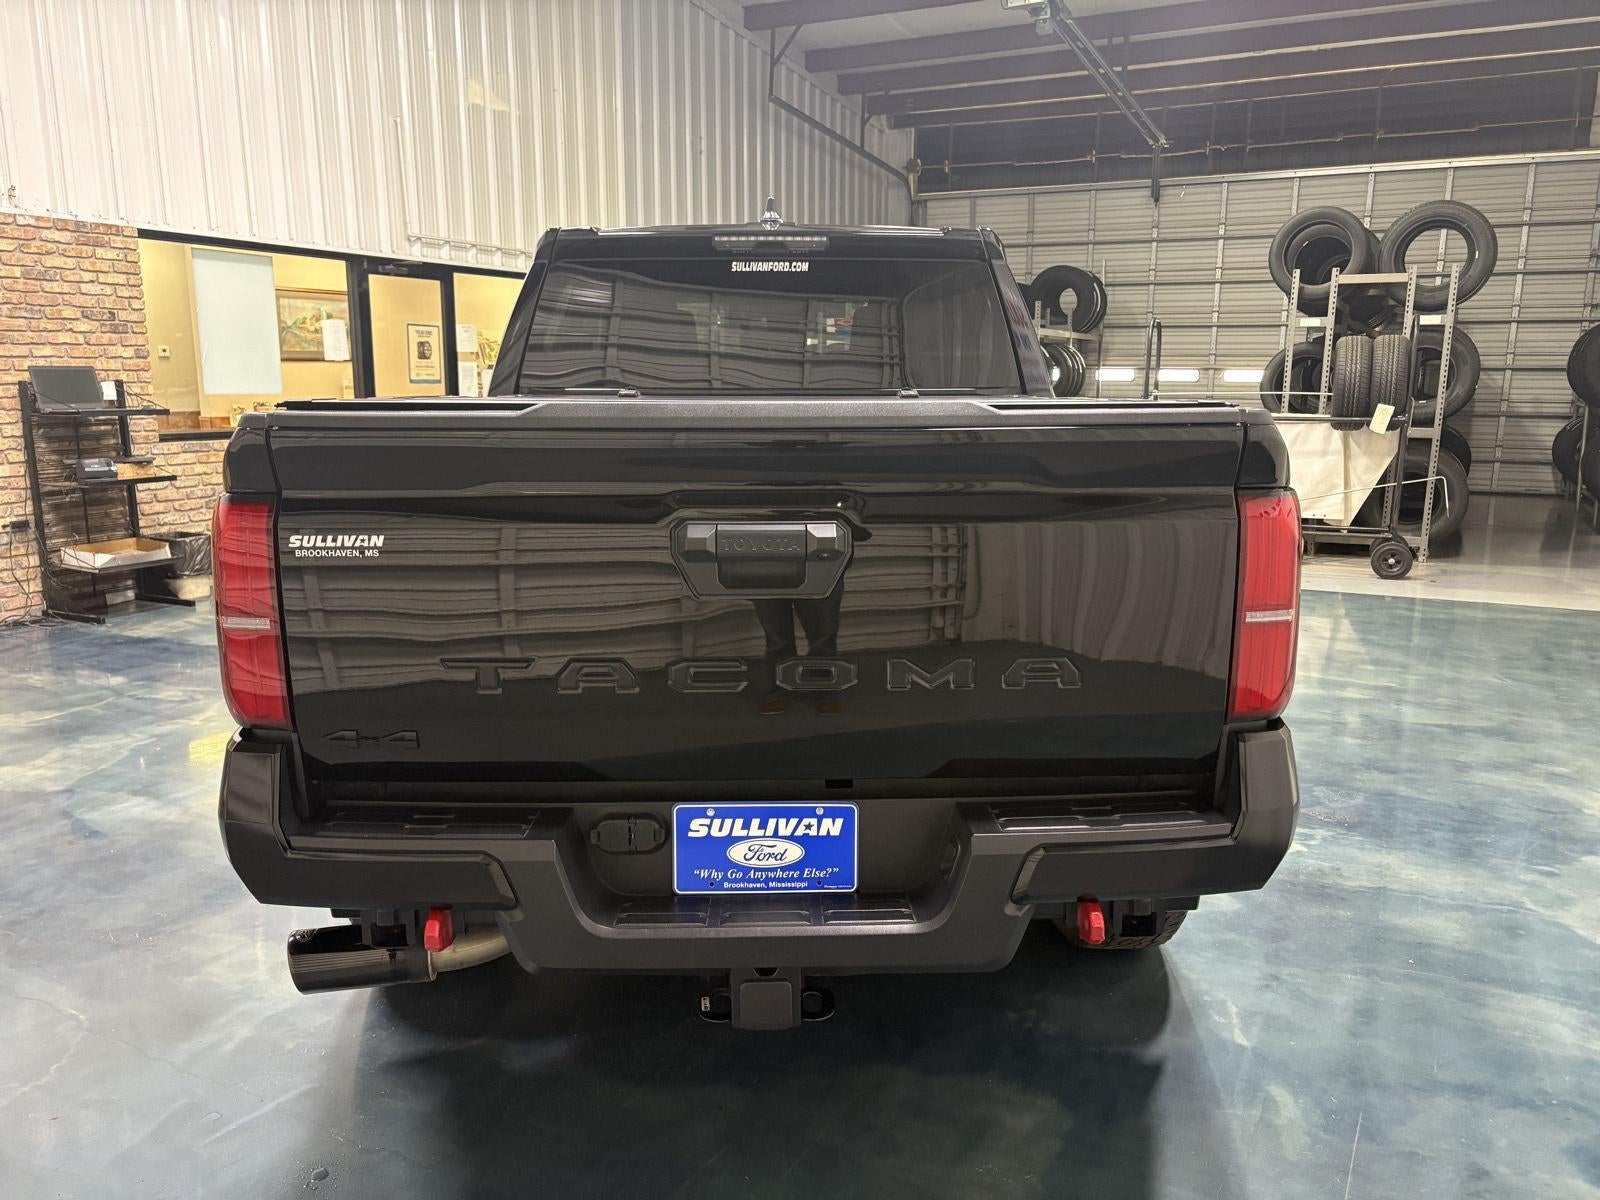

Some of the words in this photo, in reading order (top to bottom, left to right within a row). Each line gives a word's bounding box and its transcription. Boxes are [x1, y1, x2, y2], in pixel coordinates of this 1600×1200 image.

[731, 261, 810, 272] SULLIVANFORD.COM
[288, 534, 385, 548] SULLIVAN
[295, 549, 363, 558] BROOKHAVEN,
[364, 549, 380, 557] MS
[440, 656, 1084, 694] TACOMA
[688, 818, 844, 838] SULLIVAN
[743, 843, 788, 862] Ford
[727, 868, 743, 879] Go
[746, 867, 800, 881] Anywhere
[723, 881, 767, 889] Brookhaven,
[768, 881, 808, 889] Mississippi
